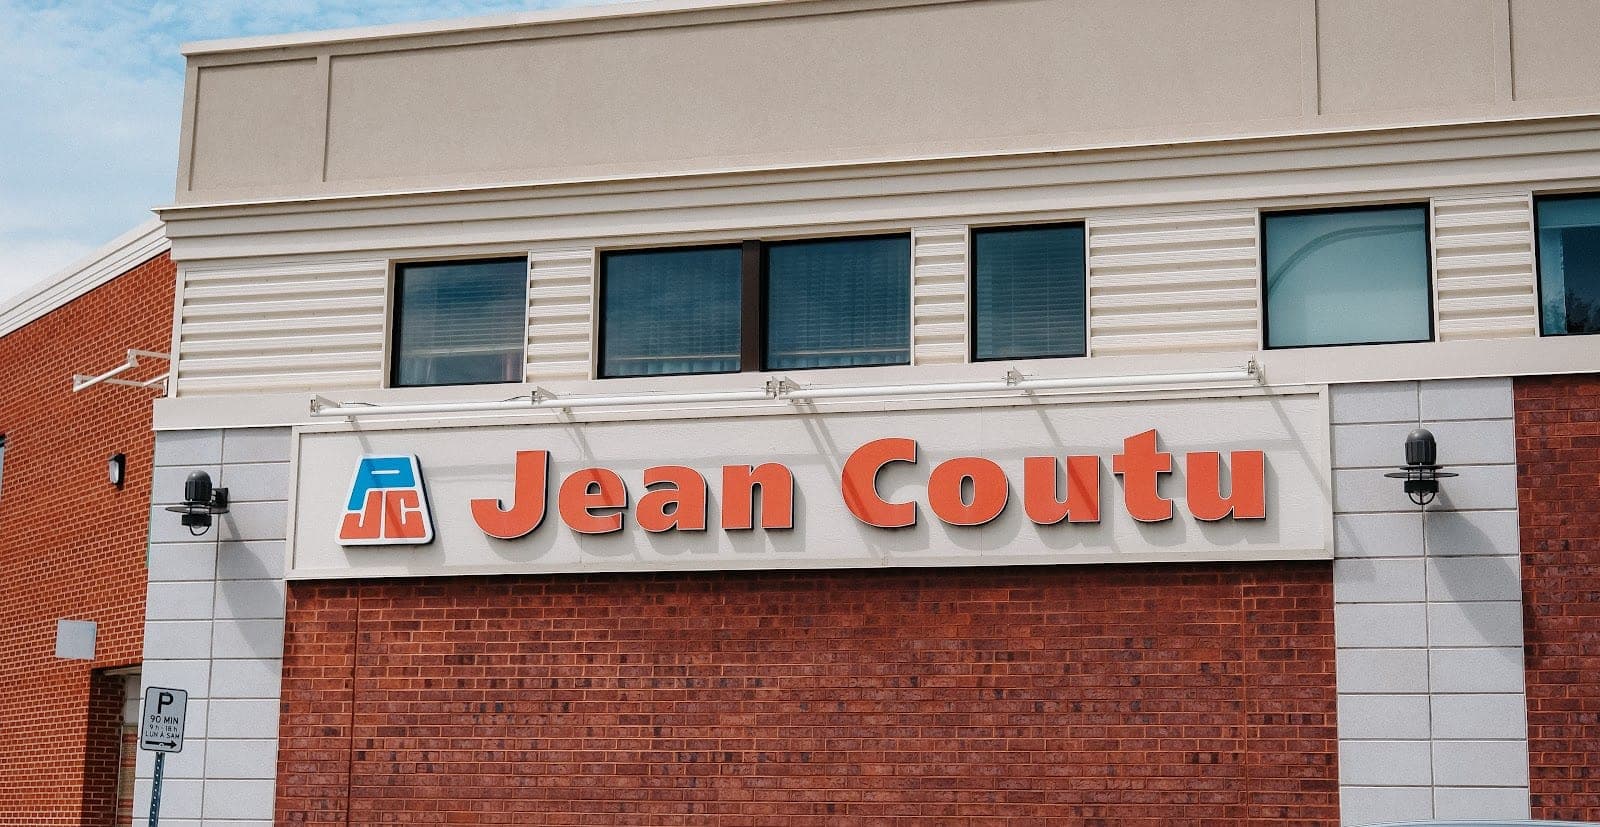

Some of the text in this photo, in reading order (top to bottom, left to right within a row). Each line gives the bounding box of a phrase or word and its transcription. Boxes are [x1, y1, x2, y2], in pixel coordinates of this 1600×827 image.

[470, 428, 1266, 539] Jean Coutu
[158, 692, 174, 714] P
[150, 715, 178, 724] 90 MIN
